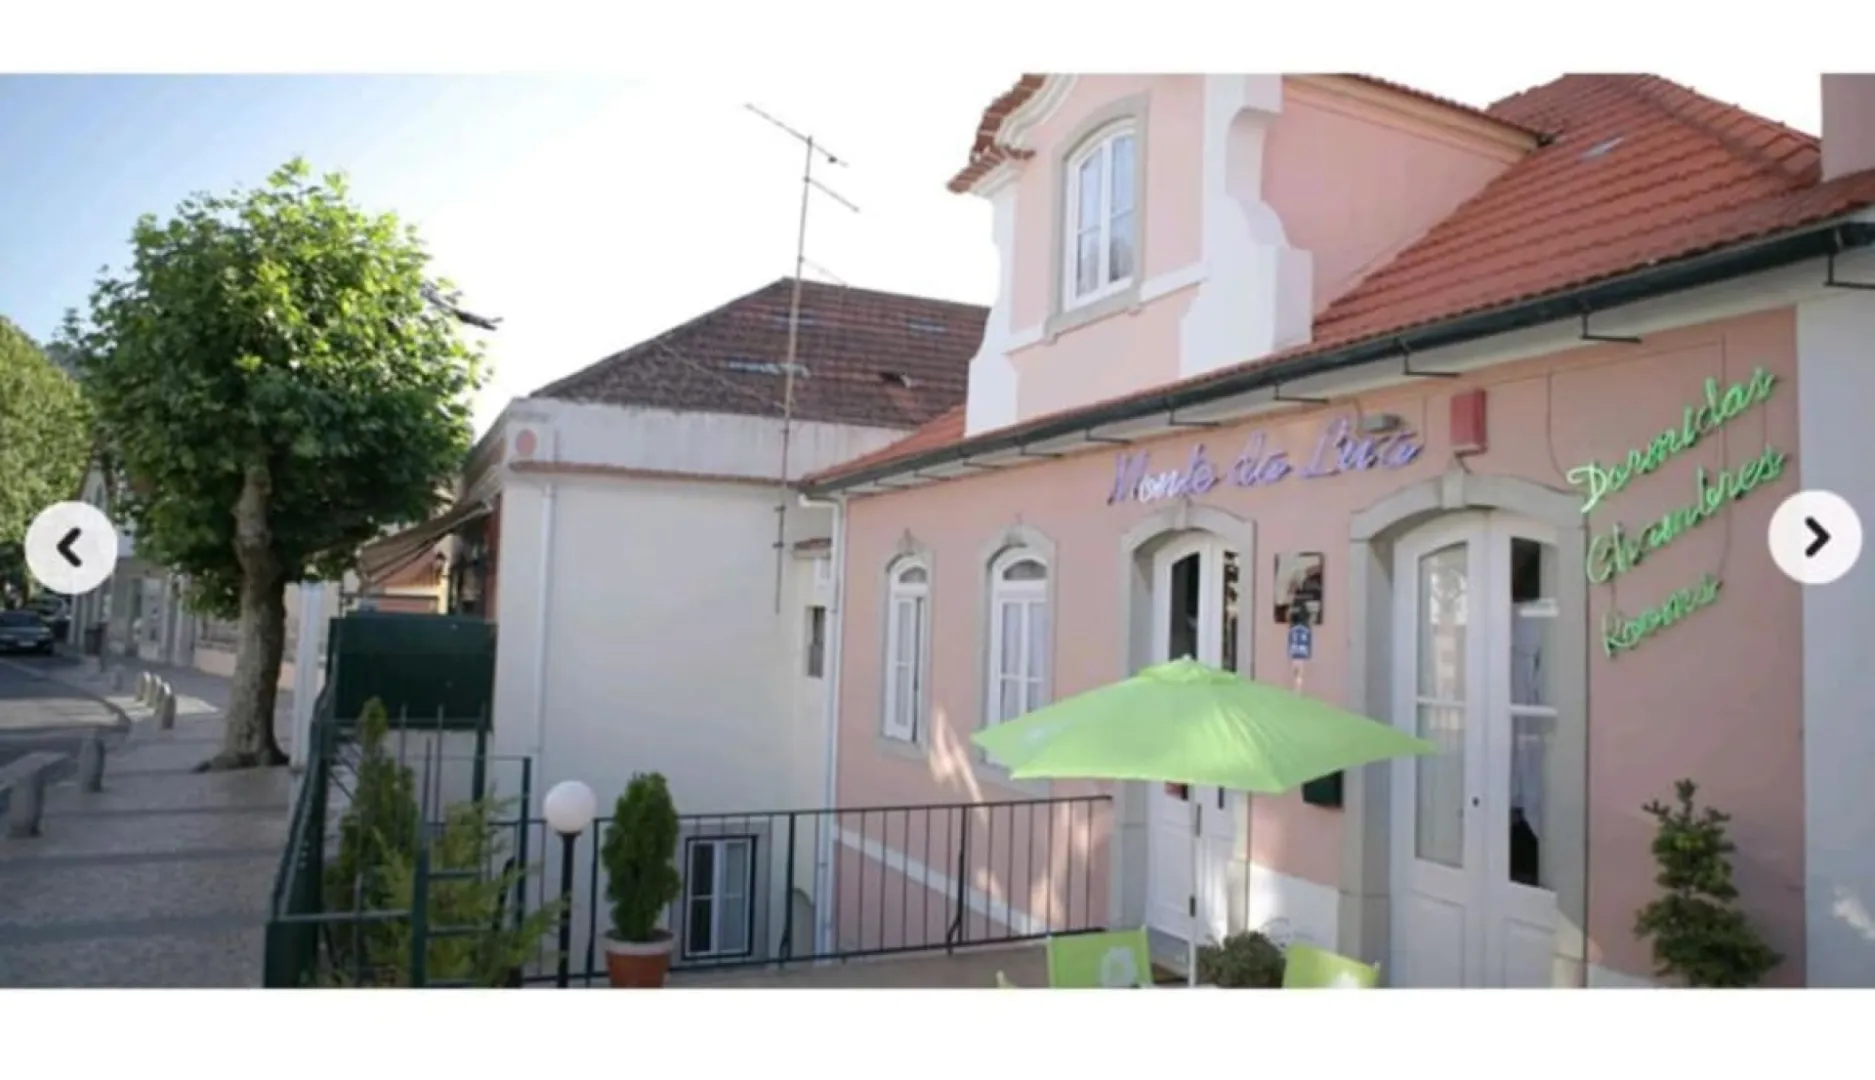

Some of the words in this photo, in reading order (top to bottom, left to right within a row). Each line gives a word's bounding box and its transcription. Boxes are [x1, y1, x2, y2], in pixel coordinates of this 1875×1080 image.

[1567, 367, 1777, 513] Dormidas
[1587, 445, 1786, 584] Chambres
[1601, 573, 1722, 656] Rooms
